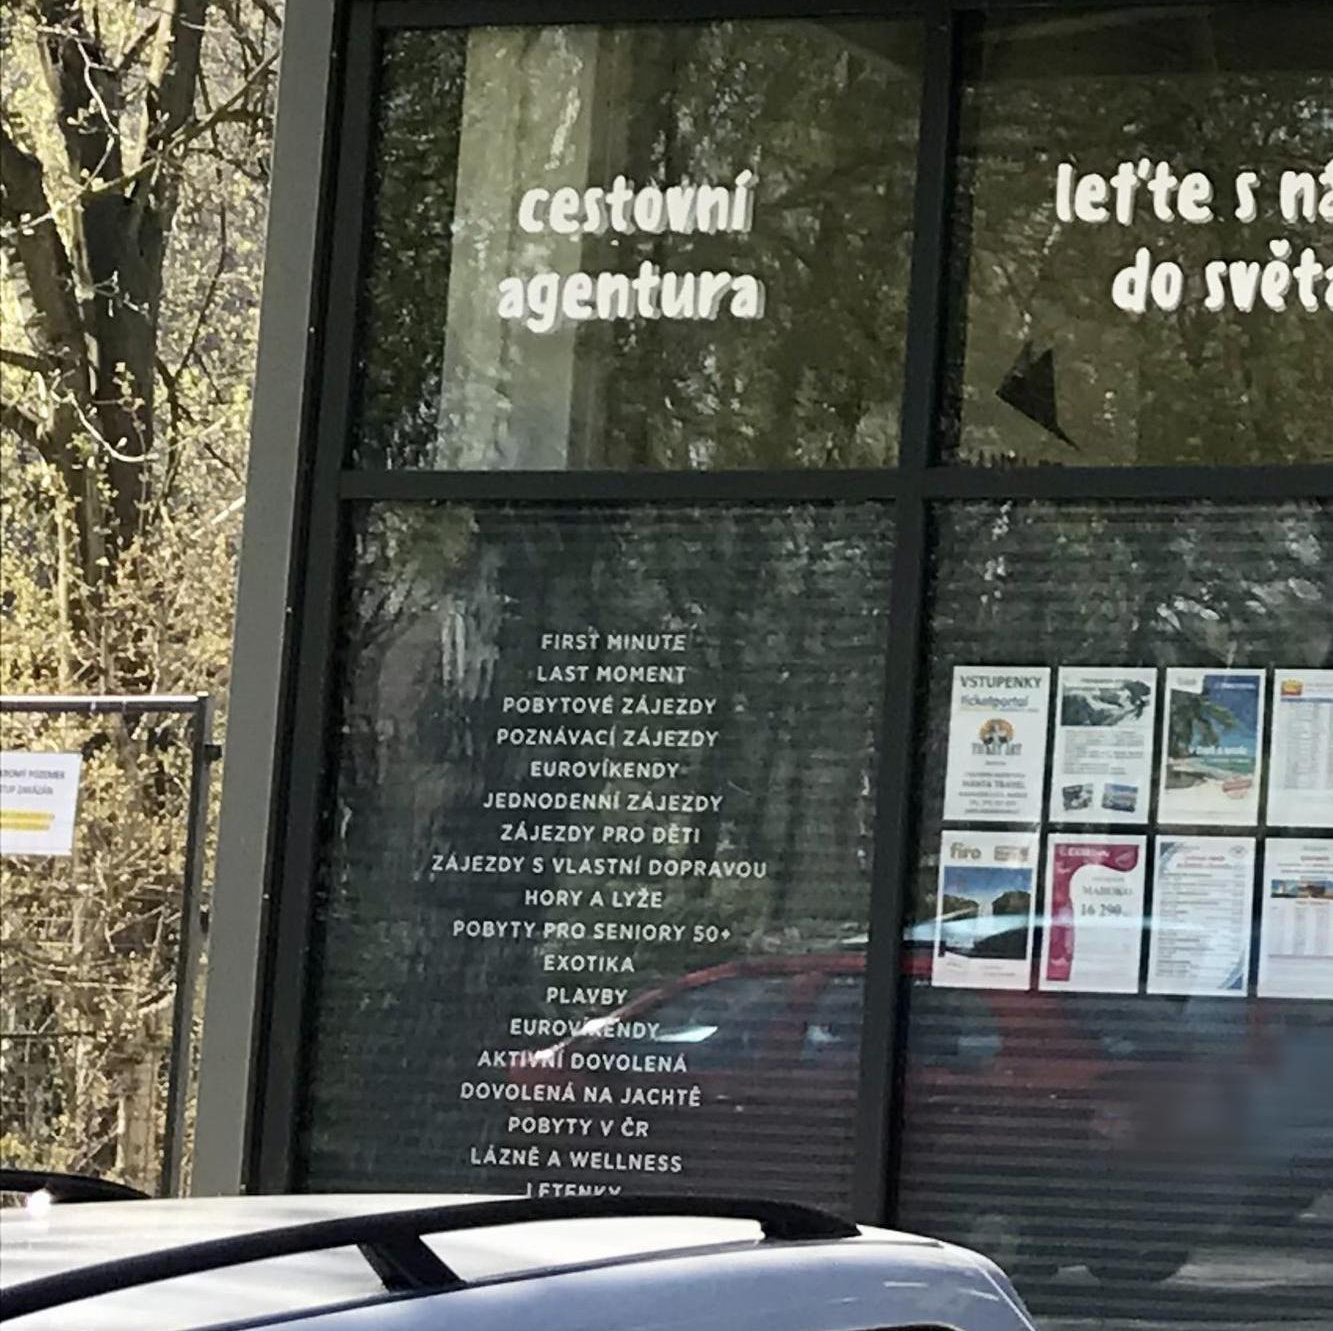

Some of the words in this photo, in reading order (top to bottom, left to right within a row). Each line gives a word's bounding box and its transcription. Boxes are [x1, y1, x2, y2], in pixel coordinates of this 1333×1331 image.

[517, 168, 755, 235] cestovní
[1055, 160, 1213, 226] leťte
[1236, 176, 1258, 224] s
[1112, 248, 1182, 314] do
[496, 261, 765, 334] agentura
[541, 634, 600, 651] FIRST
[606, 634, 687, 652] MINUTE
[537, 665, 589, 683] LAST
[596, 666, 687, 685] MOMENT
[960, 674, 1042, 690] VSTUPENKY
[502, 694, 614, 714] POBYTOVÉ
[621, 695, 718, 716] ZÁJEZDY
[496, 725, 617, 747] POZNÁVACÍ
[622, 726, 719, 747] ZÁJEZDY
[530, 758, 680, 779] EUROVÍKENDY
[483, 789, 621, 810] JEDNODENNÍ
[626, 791, 724, 812] ZÁJEZDY
[500, 821, 596, 842] ZÁJEZDY
[602, 826, 645, 843] PRO
[651, 822, 701, 845] DĚTI
[431, 851, 525, 872] ZÁJEZDY
[532, 856, 544, 873] S
[551, 855, 642, 876] VLASTNÍ
[648, 859, 767, 879] DOPRAVOU
[524, 889, 583, 907] HORY
[590, 890, 604, 907] A
[612, 886, 663, 908] LYŽE
[452, 919, 536, 939] POBYTY
[543, 922, 586, 940] PRO
[593, 923, 686, 941] SENIORY
[692, 925, 731, 942] 50+
[543, 955, 635, 973] EXOTIKA
[546, 987, 628, 1005] PLAVBY
[477, 1049, 564, 1069] AKTIVNÍ
[570, 1052, 687, 1073] DOVOLENÁ
[460, 1081, 575, 1103] DOVOLENÁ
[583, 1087, 613, 1104] NA
[620, 1084, 702, 1107] JACHTĚ
[508, 1117, 592, 1135] POBYTY
[600, 1120, 615, 1136] V
[621, 1116, 649, 1138] ČR
[470, 1144, 540, 1167] LÁZNĚ
[547, 1151, 561, 1168] A
[569, 1151, 683, 1174] WELLNESS
